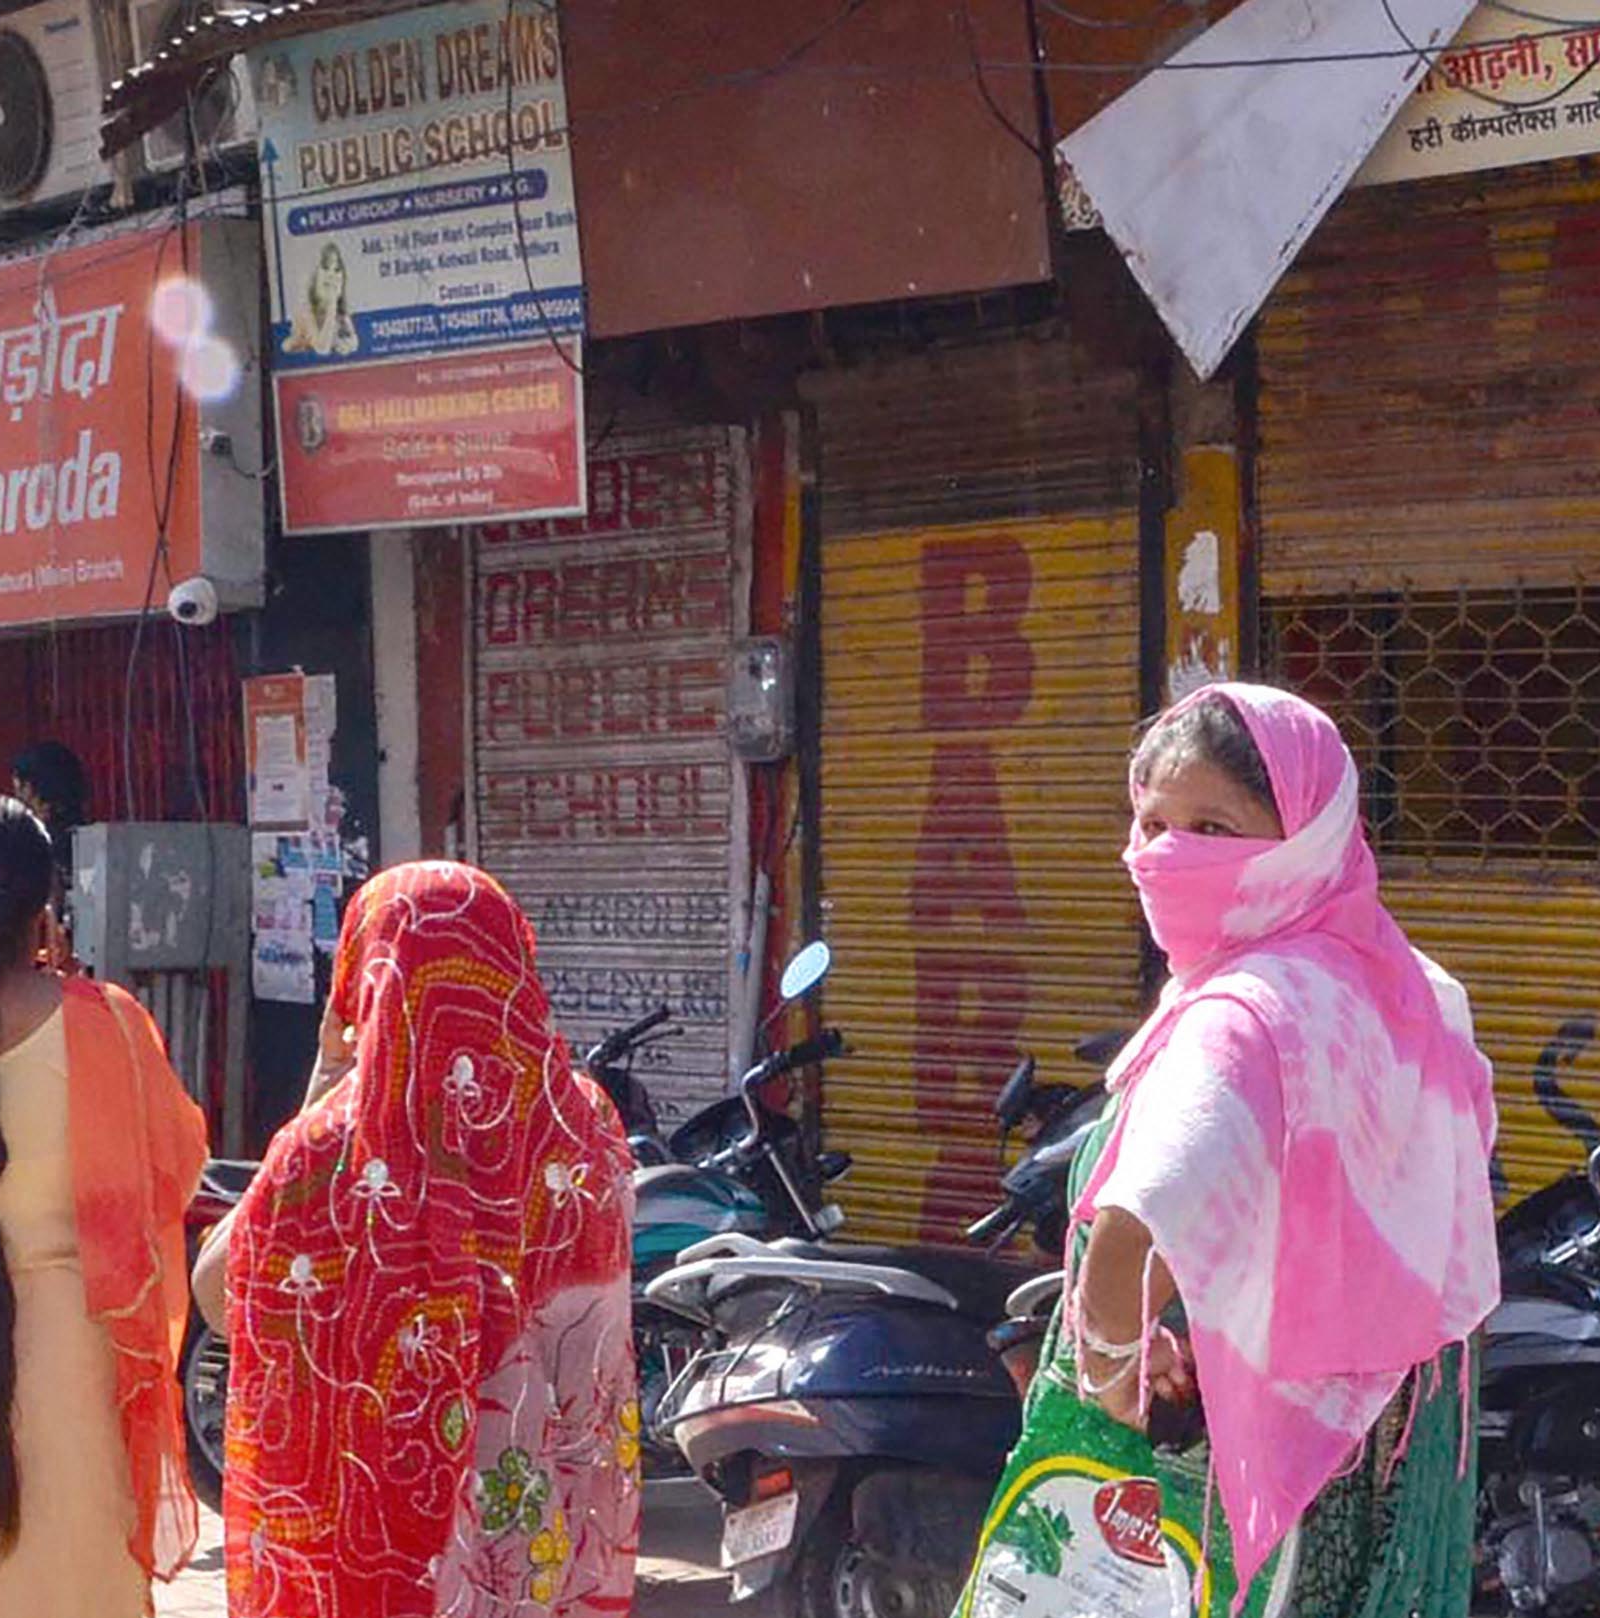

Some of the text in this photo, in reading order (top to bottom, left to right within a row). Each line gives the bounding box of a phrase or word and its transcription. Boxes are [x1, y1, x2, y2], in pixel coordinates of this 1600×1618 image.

[311, 13, 559, 123] GOLDEN DREAMS
[299, 102, 564, 189] PUBLIC SCHOOL
[1408, 117, 1443, 151] हरी
